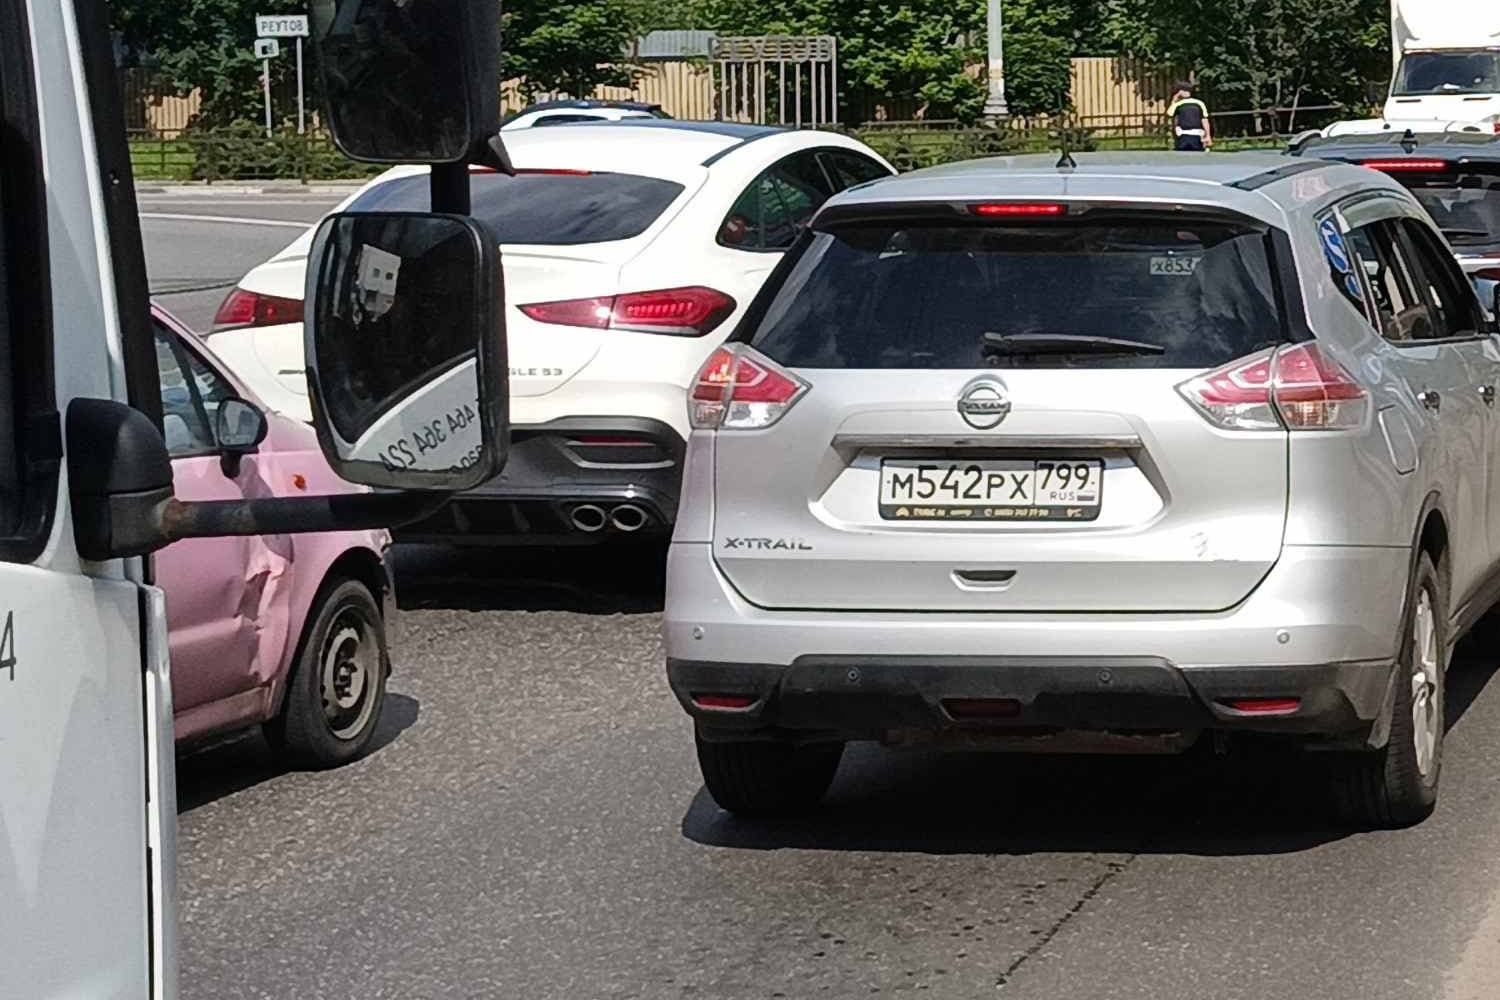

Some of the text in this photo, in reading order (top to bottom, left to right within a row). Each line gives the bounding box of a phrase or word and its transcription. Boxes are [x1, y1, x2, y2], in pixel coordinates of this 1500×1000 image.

[892, 463, 1090, 499] М542РХ 799
[1050, 491, 1075, 501] RUS
